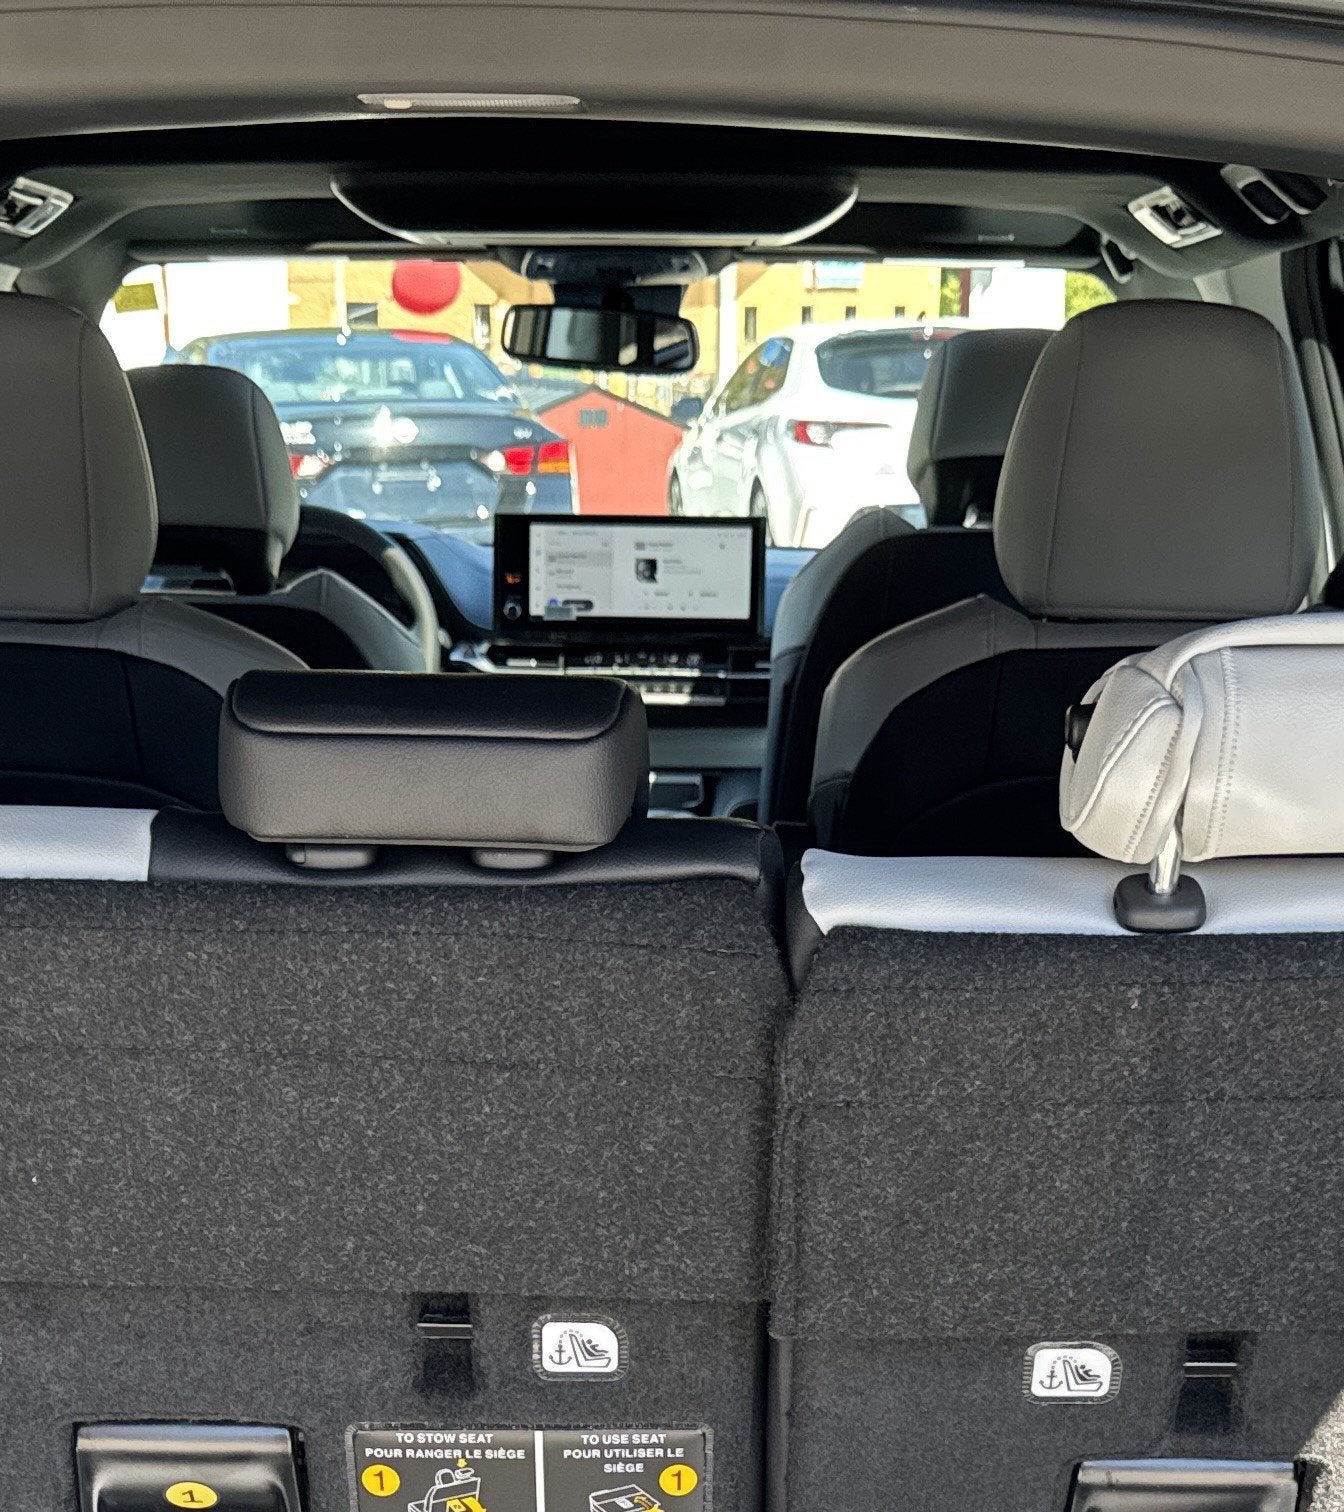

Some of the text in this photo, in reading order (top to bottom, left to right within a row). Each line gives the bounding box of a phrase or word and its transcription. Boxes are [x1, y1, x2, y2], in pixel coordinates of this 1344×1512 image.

[395, 1432, 494, 1443] TO STOW SEAT
[580, 1433, 667, 1445] TO USE SEAT
[364, 1446, 526, 1459] POUR RANGER LE SIÈGE
[563, 1447, 685, 1459] POUR UTILISER LE
[603, 1461, 644, 1473] SIÈGE
[373, 1470, 385, 1491] 1
[671, 1469, 682, 1491] 1
